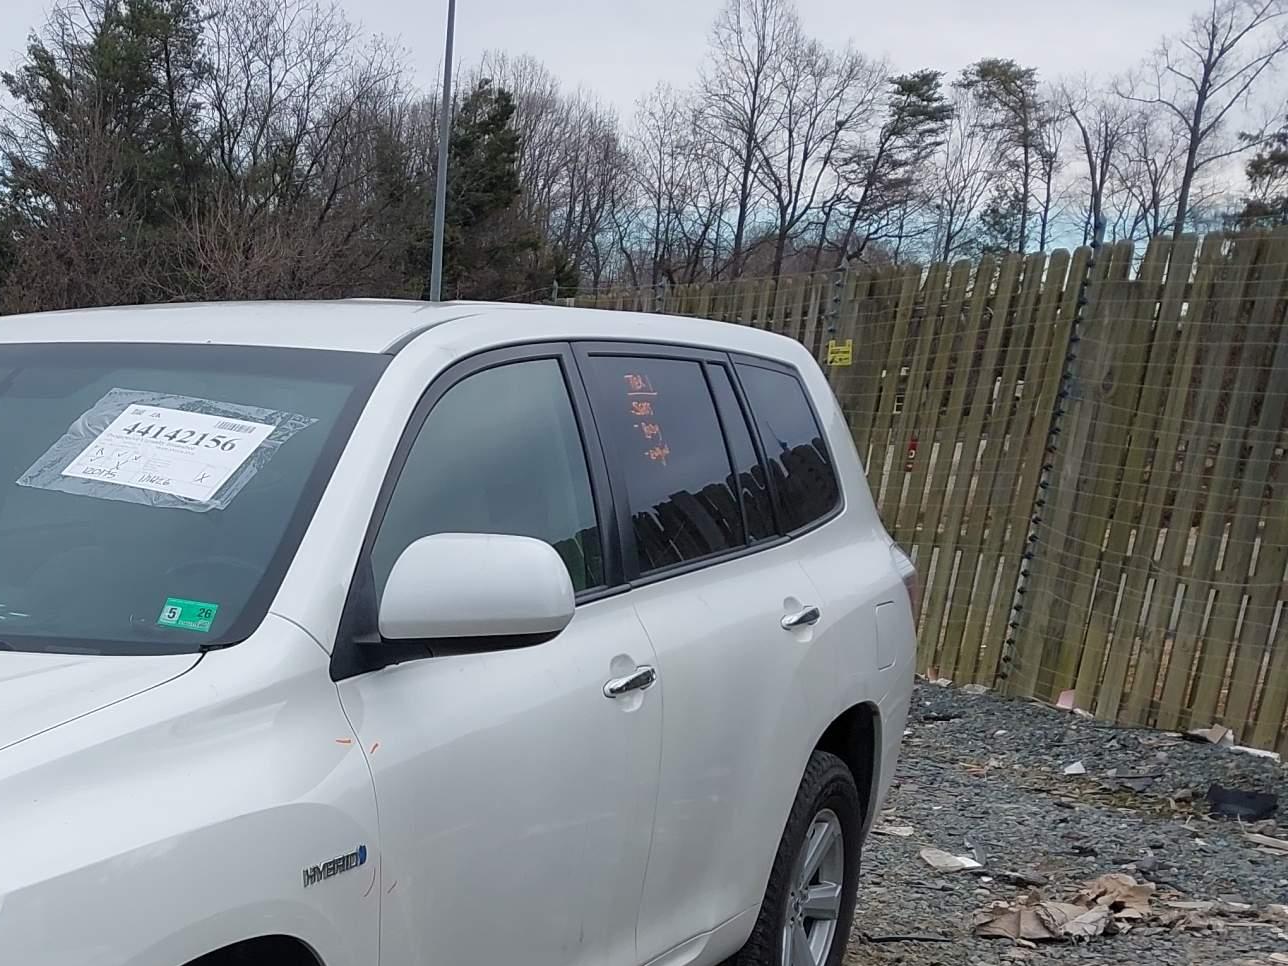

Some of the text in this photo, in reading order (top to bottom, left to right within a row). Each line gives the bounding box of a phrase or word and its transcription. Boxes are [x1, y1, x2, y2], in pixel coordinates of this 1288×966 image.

[123, 421, 238, 452] 44142156
[167, 607, 213, 619] 5 26
[302, 850, 359, 888] HYBRID
